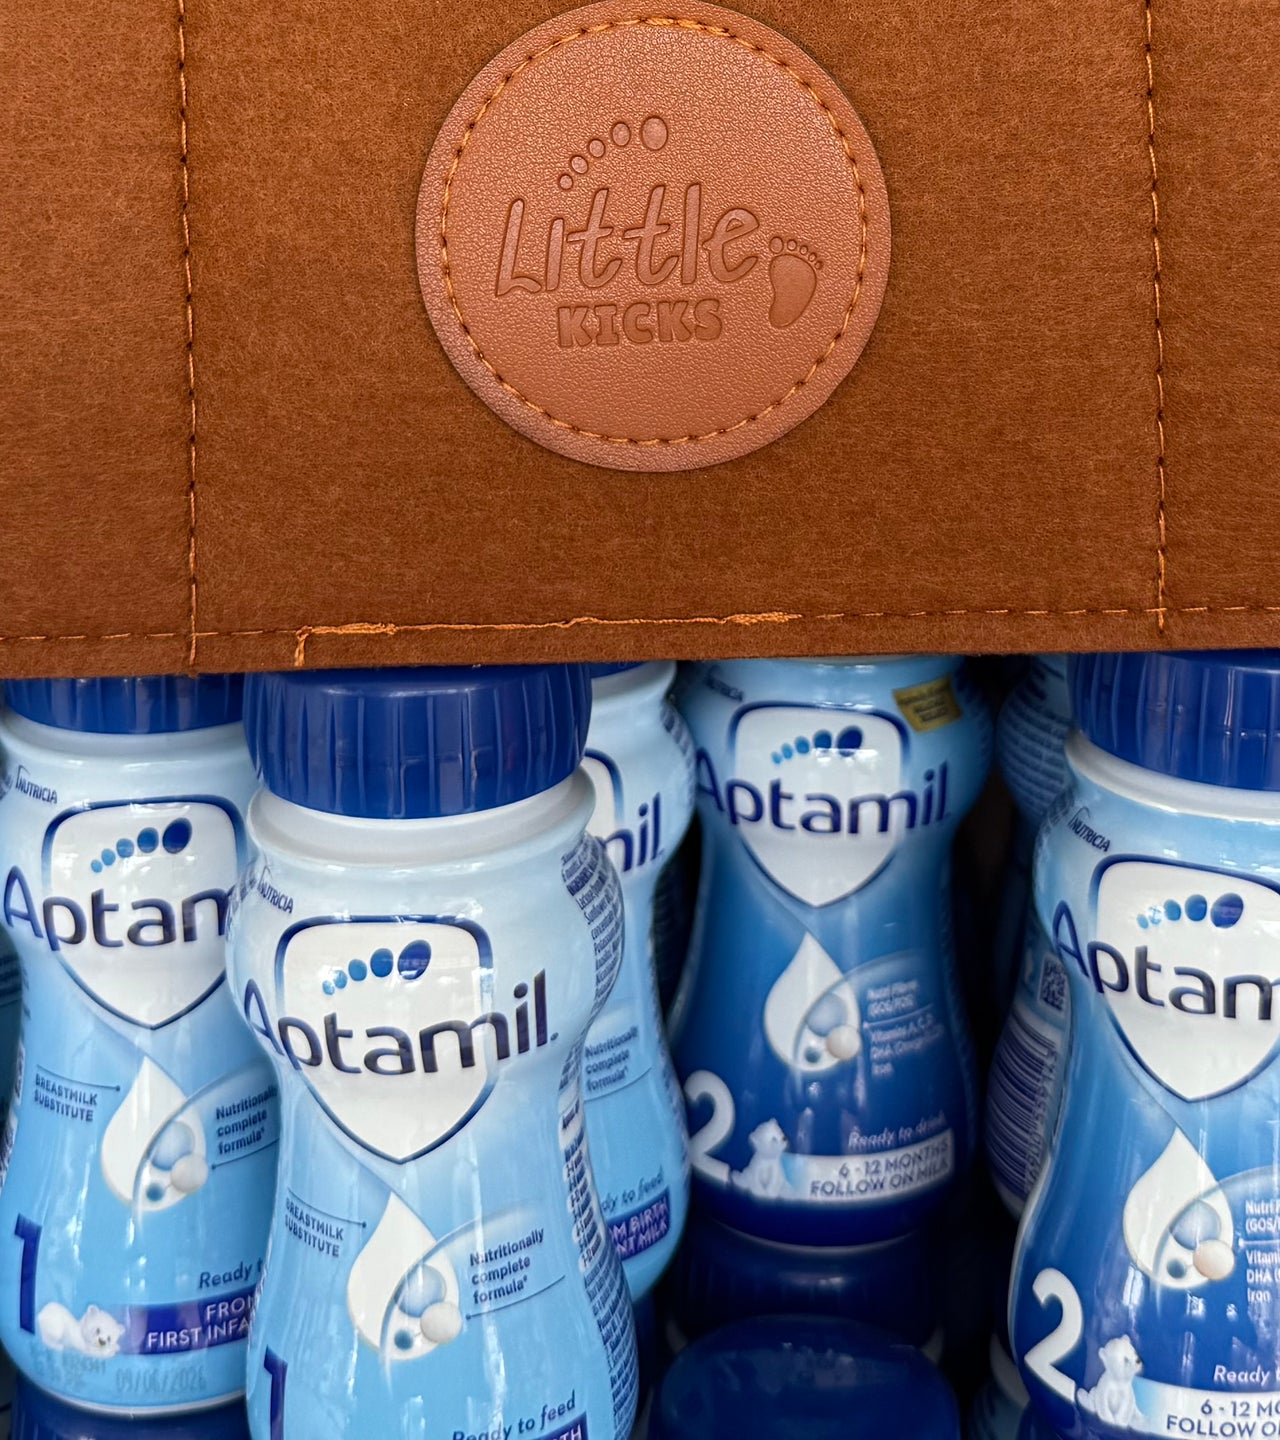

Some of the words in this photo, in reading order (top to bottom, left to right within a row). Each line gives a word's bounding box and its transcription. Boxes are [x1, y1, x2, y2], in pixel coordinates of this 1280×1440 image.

[494, 182, 761, 297] Little
[557, 298, 723, 349] KICKS
[17, 776, 58, 805] NUTRICIA
[695, 746, 950, 835] Aptamil
[1070, 817, 1111, 853] NUTRICIA
[258, 878, 295, 915] NUTRICIA
[243, 968, 550, 1076] Aptamil
[34, 1072, 98, 1107] BREASTMILK
[34, 1090, 94, 1124] SUBSTITUTE
[216, 1108, 268, 1138] complete
[838, 1162, 850, 1179] 6
[883, 1139, 949, 1173] MONTHS
[810, 1174, 886, 1198] FOLLOW
[889, 1169, 915, 1190] ON
[915, 1159, 949, 1182] MILK
[284, 1196, 344, 1242] BREASTMILK
[1245, 1198, 1275, 1215] Nutri
[283, 1213, 341, 1259] SUBSTITUTE
[468, 1225, 545, 1268] Nutritionally
[13, 1212, 43, 1336] 1
[198, 1261, 253, 1290] Ready
[470, 1255, 532, 1287] complete
[1246, 1268, 1273, 1285] DHA
[1246, 1287, 1271, 1304] Iron
[147, 1326, 202, 1350] FIRST
[1023, 1266, 1084, 1405] 2
[264, 1344, 289, 1440] 1
[1212, 1363, 1272, 1387] Ready
[518, 1417, 536, 1435] to
[540, 1388, 576, 1432] feed
[1165, 1412, 1257, 1438] FOLLOW
[1199, 1396, 1213, 1416] 6
[1229, 1399, 1251, 1418] 12
